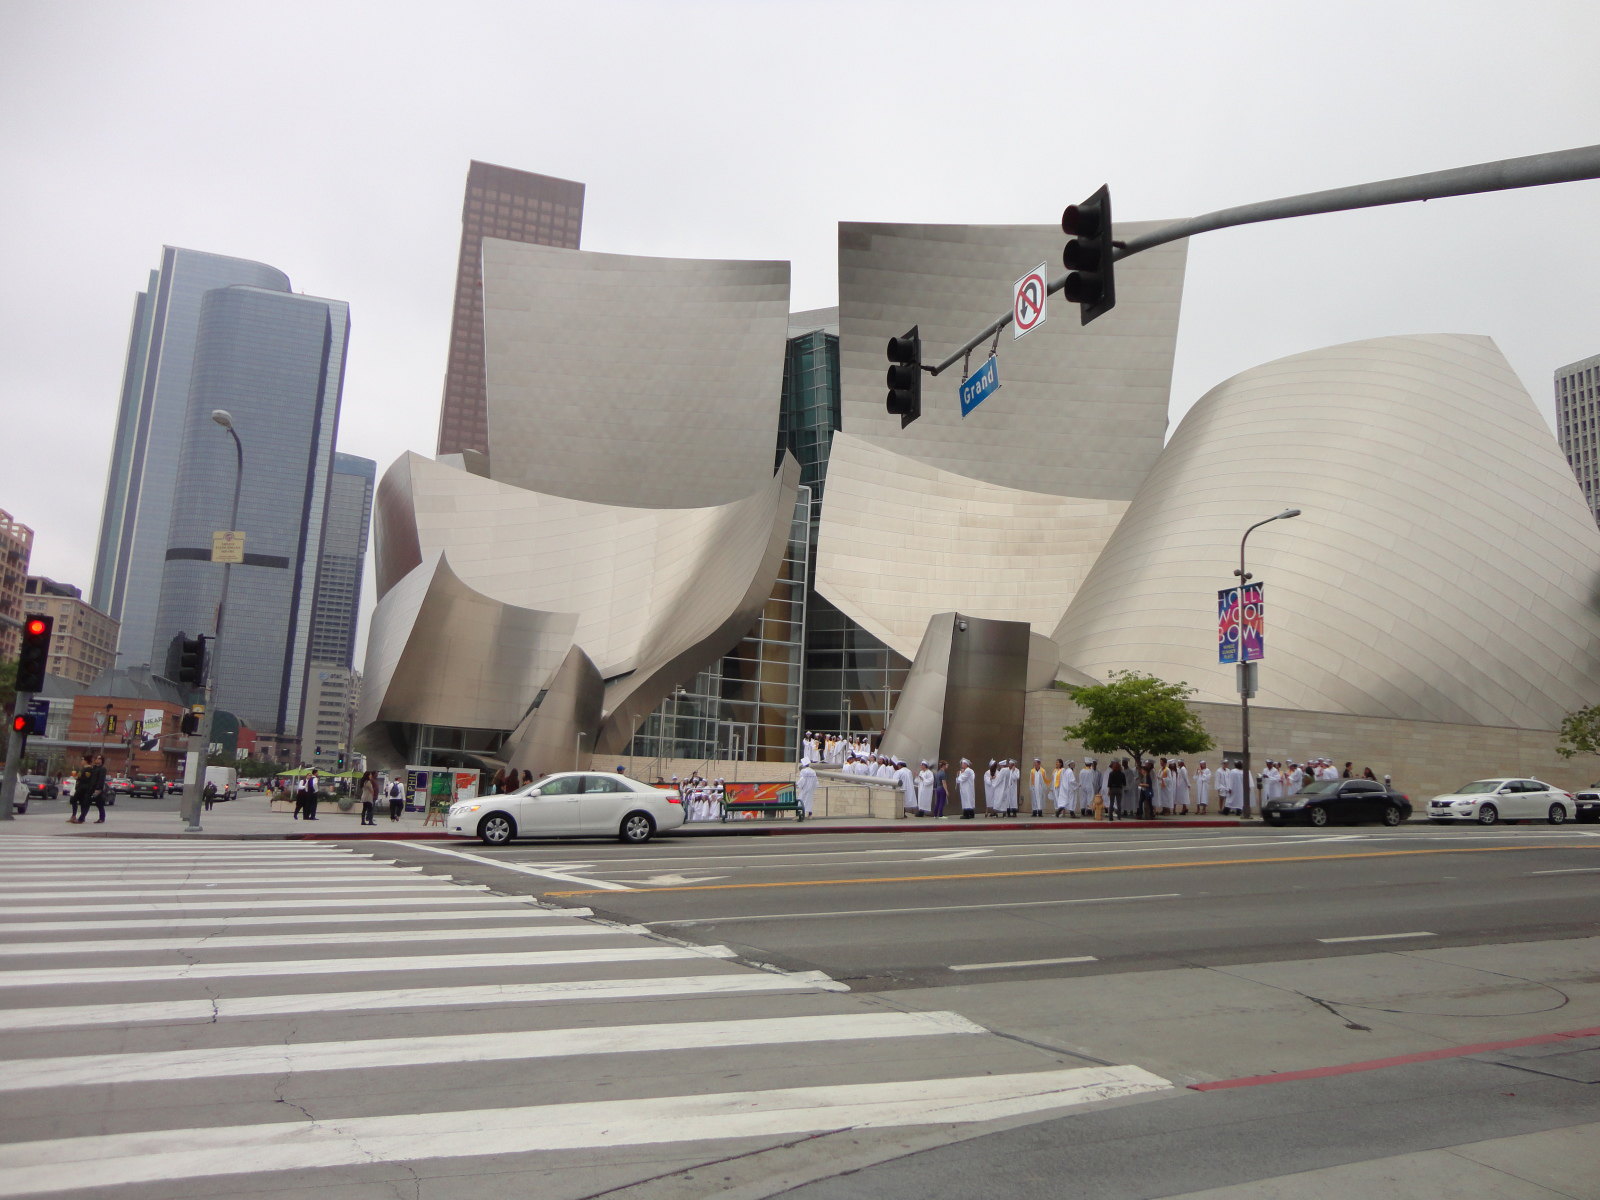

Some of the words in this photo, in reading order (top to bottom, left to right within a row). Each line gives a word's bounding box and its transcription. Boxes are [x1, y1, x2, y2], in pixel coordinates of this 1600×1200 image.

[964, 365, 993, 404] Grand
[408, 773, 417, 792] PHIL
[407, 794, 415, 805] LA
